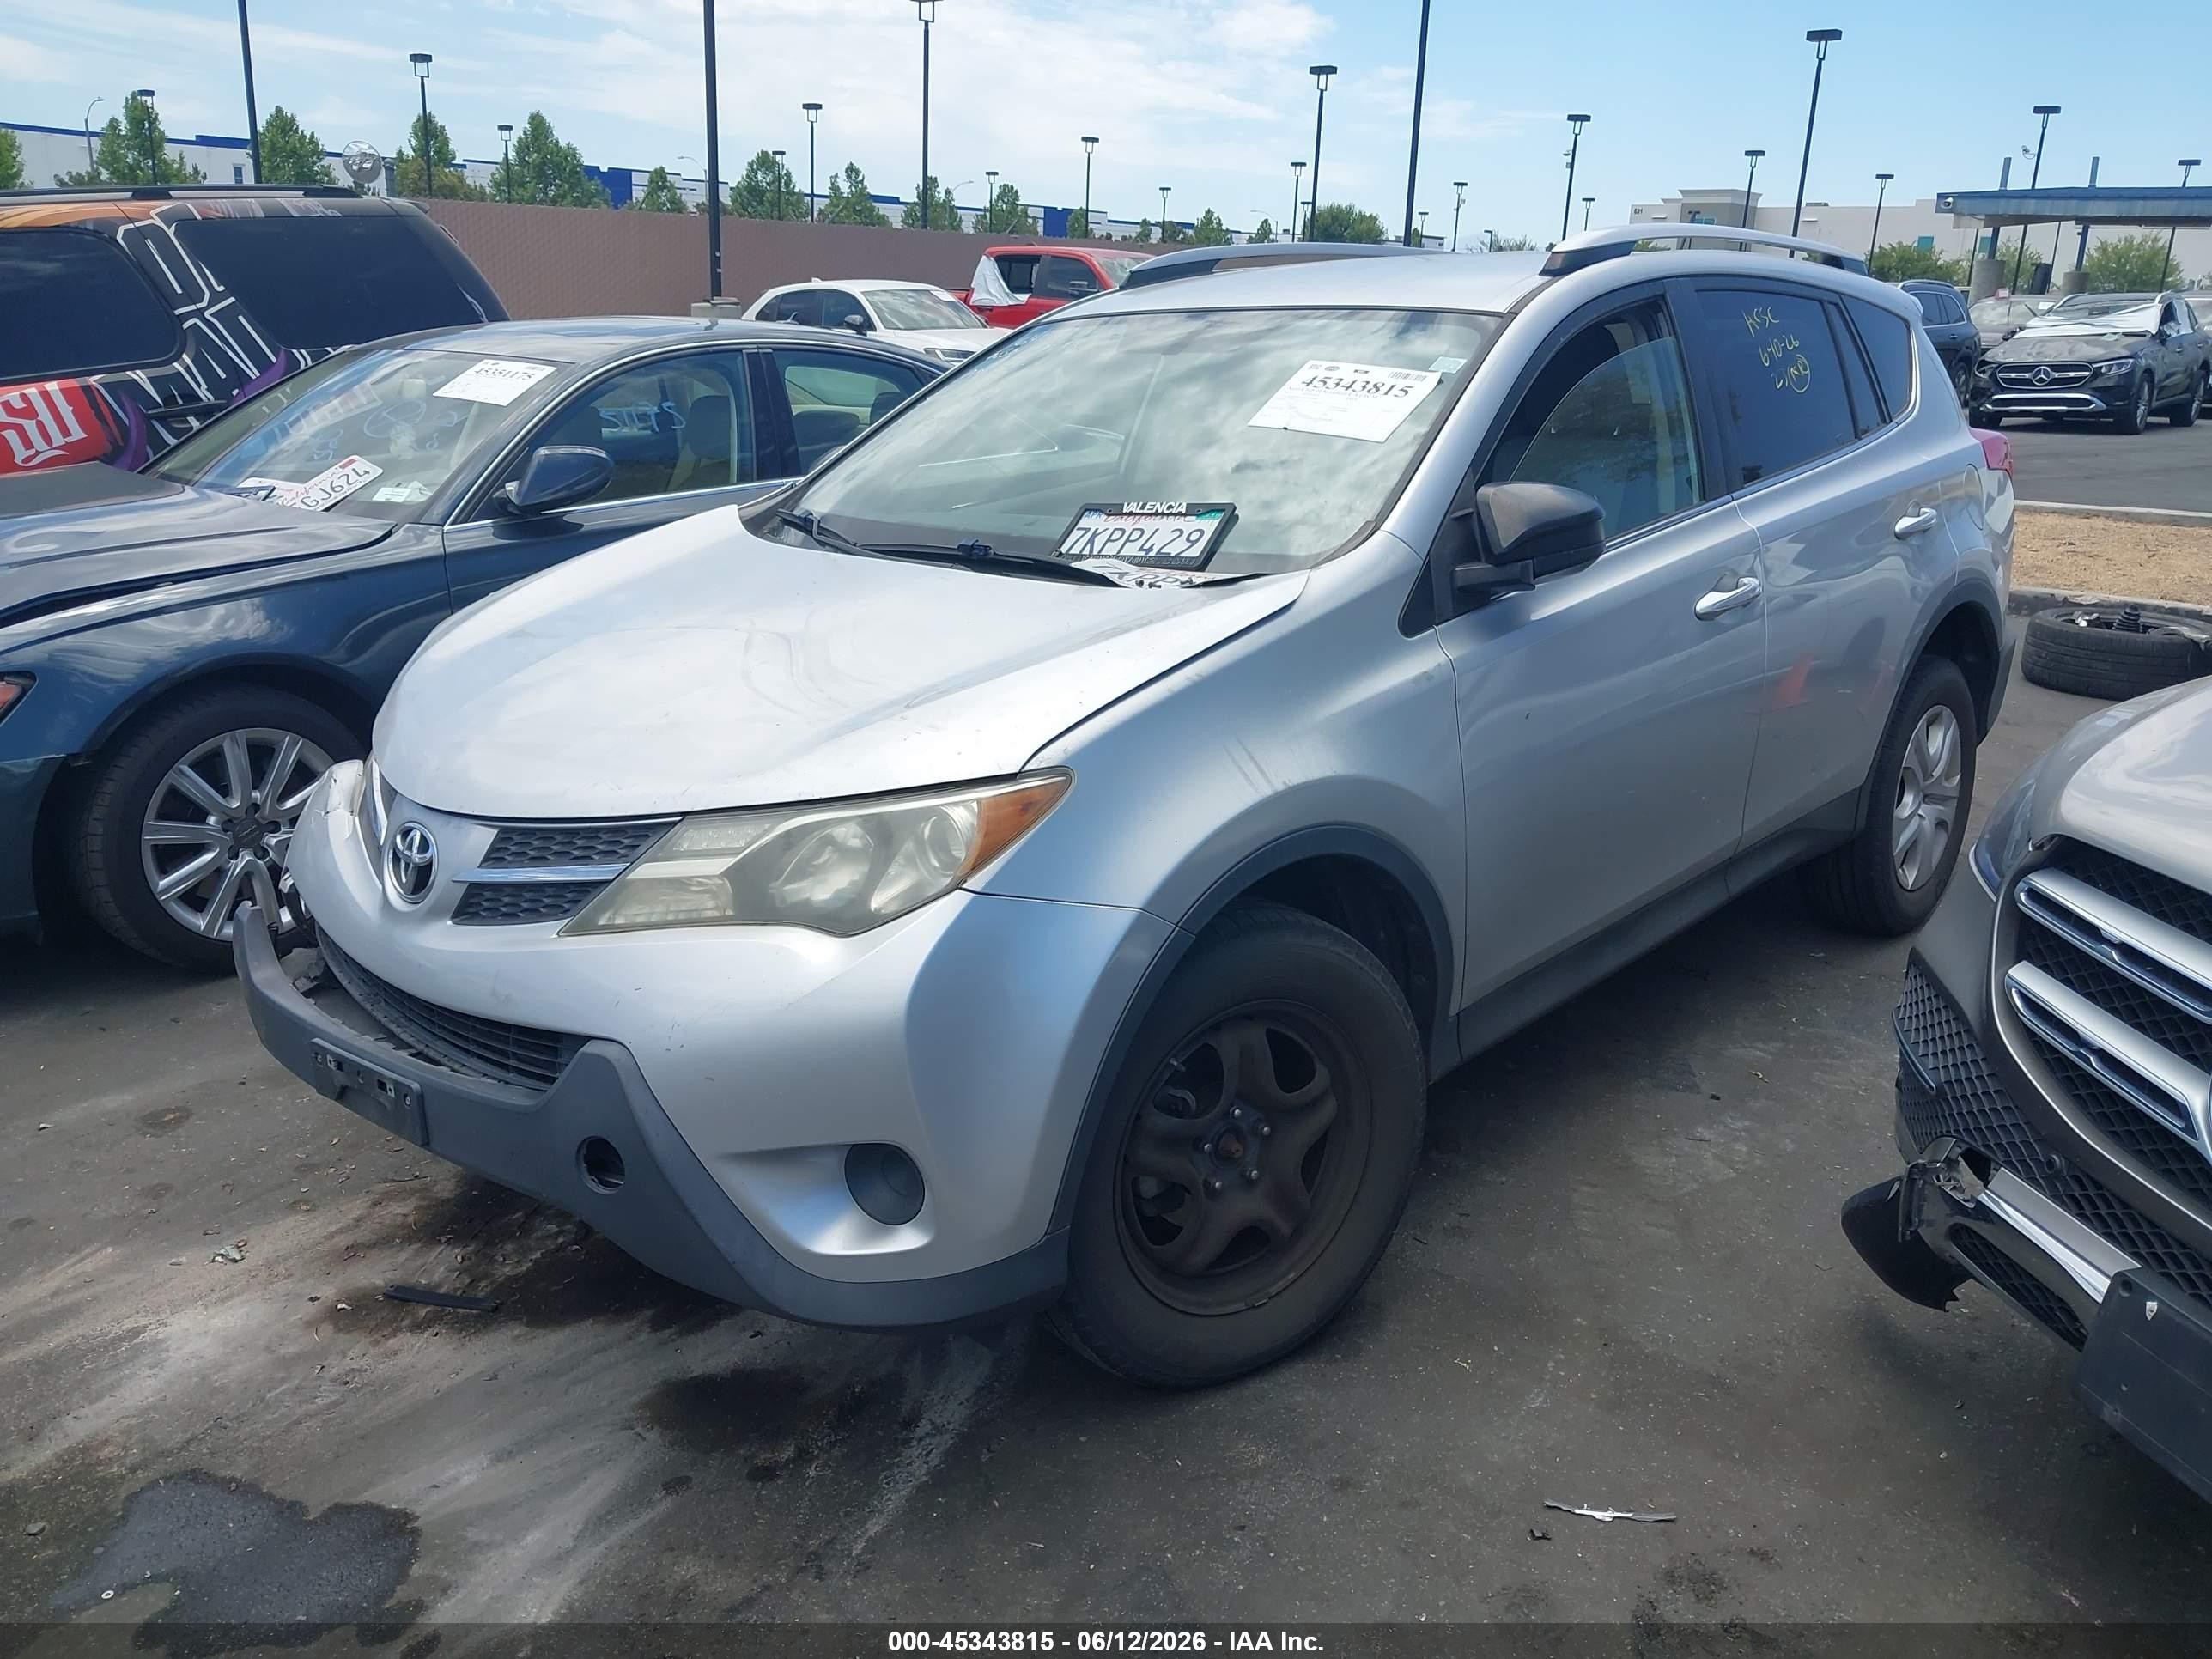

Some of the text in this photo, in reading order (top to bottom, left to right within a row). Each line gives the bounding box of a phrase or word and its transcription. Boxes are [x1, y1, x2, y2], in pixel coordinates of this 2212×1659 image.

[1300, 374, 1415, 398] 45343815
[292, 467, 371, 509] GJ624
[1121, 501, 1187, 514] VALENCIA
[1066, 526, 1206, 556] 7KPP429
